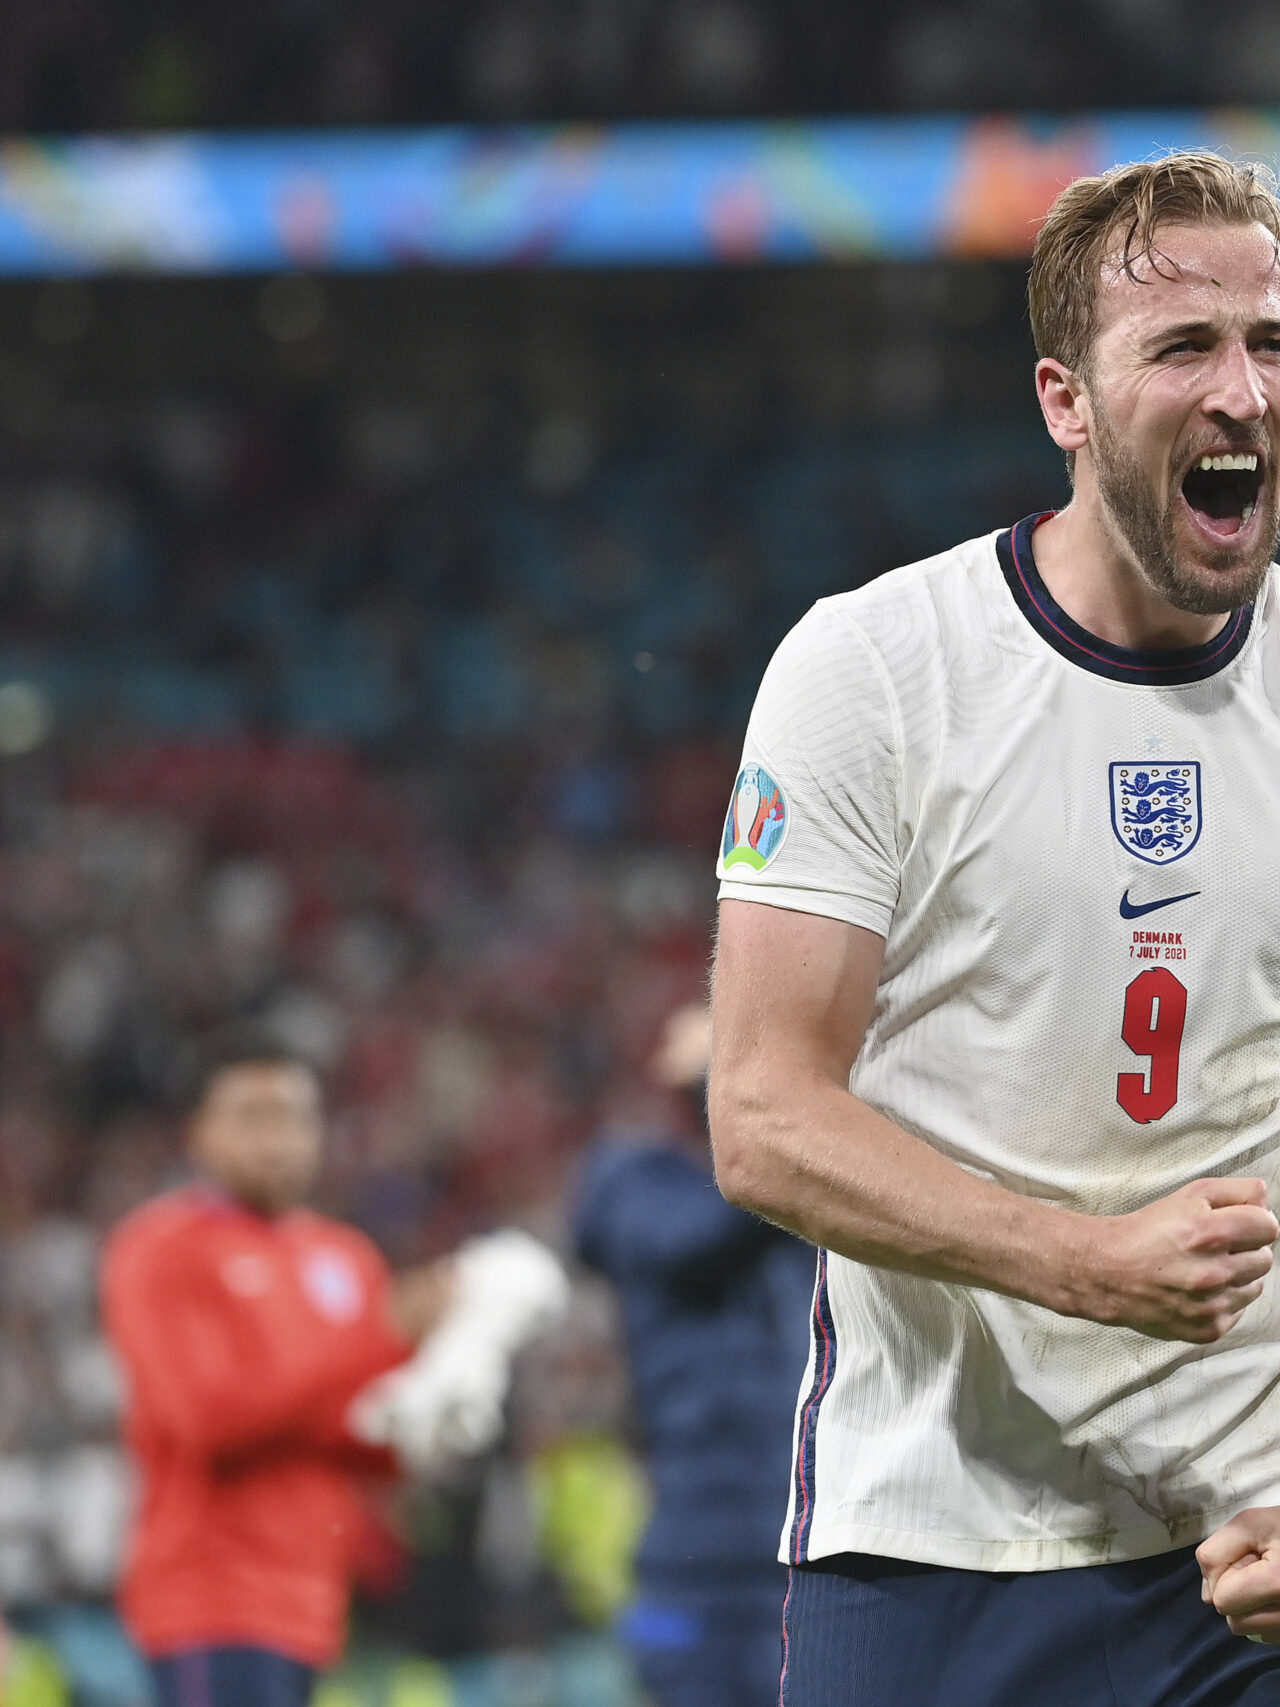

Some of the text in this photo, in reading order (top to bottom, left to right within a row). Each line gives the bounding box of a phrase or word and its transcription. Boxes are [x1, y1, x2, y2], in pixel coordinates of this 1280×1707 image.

[1133, 931, 1183, 945] DENMARK
[1129, 945, 1187, 960] 7 JULY 2021
[1116, 966, 1188, 1125] 9
